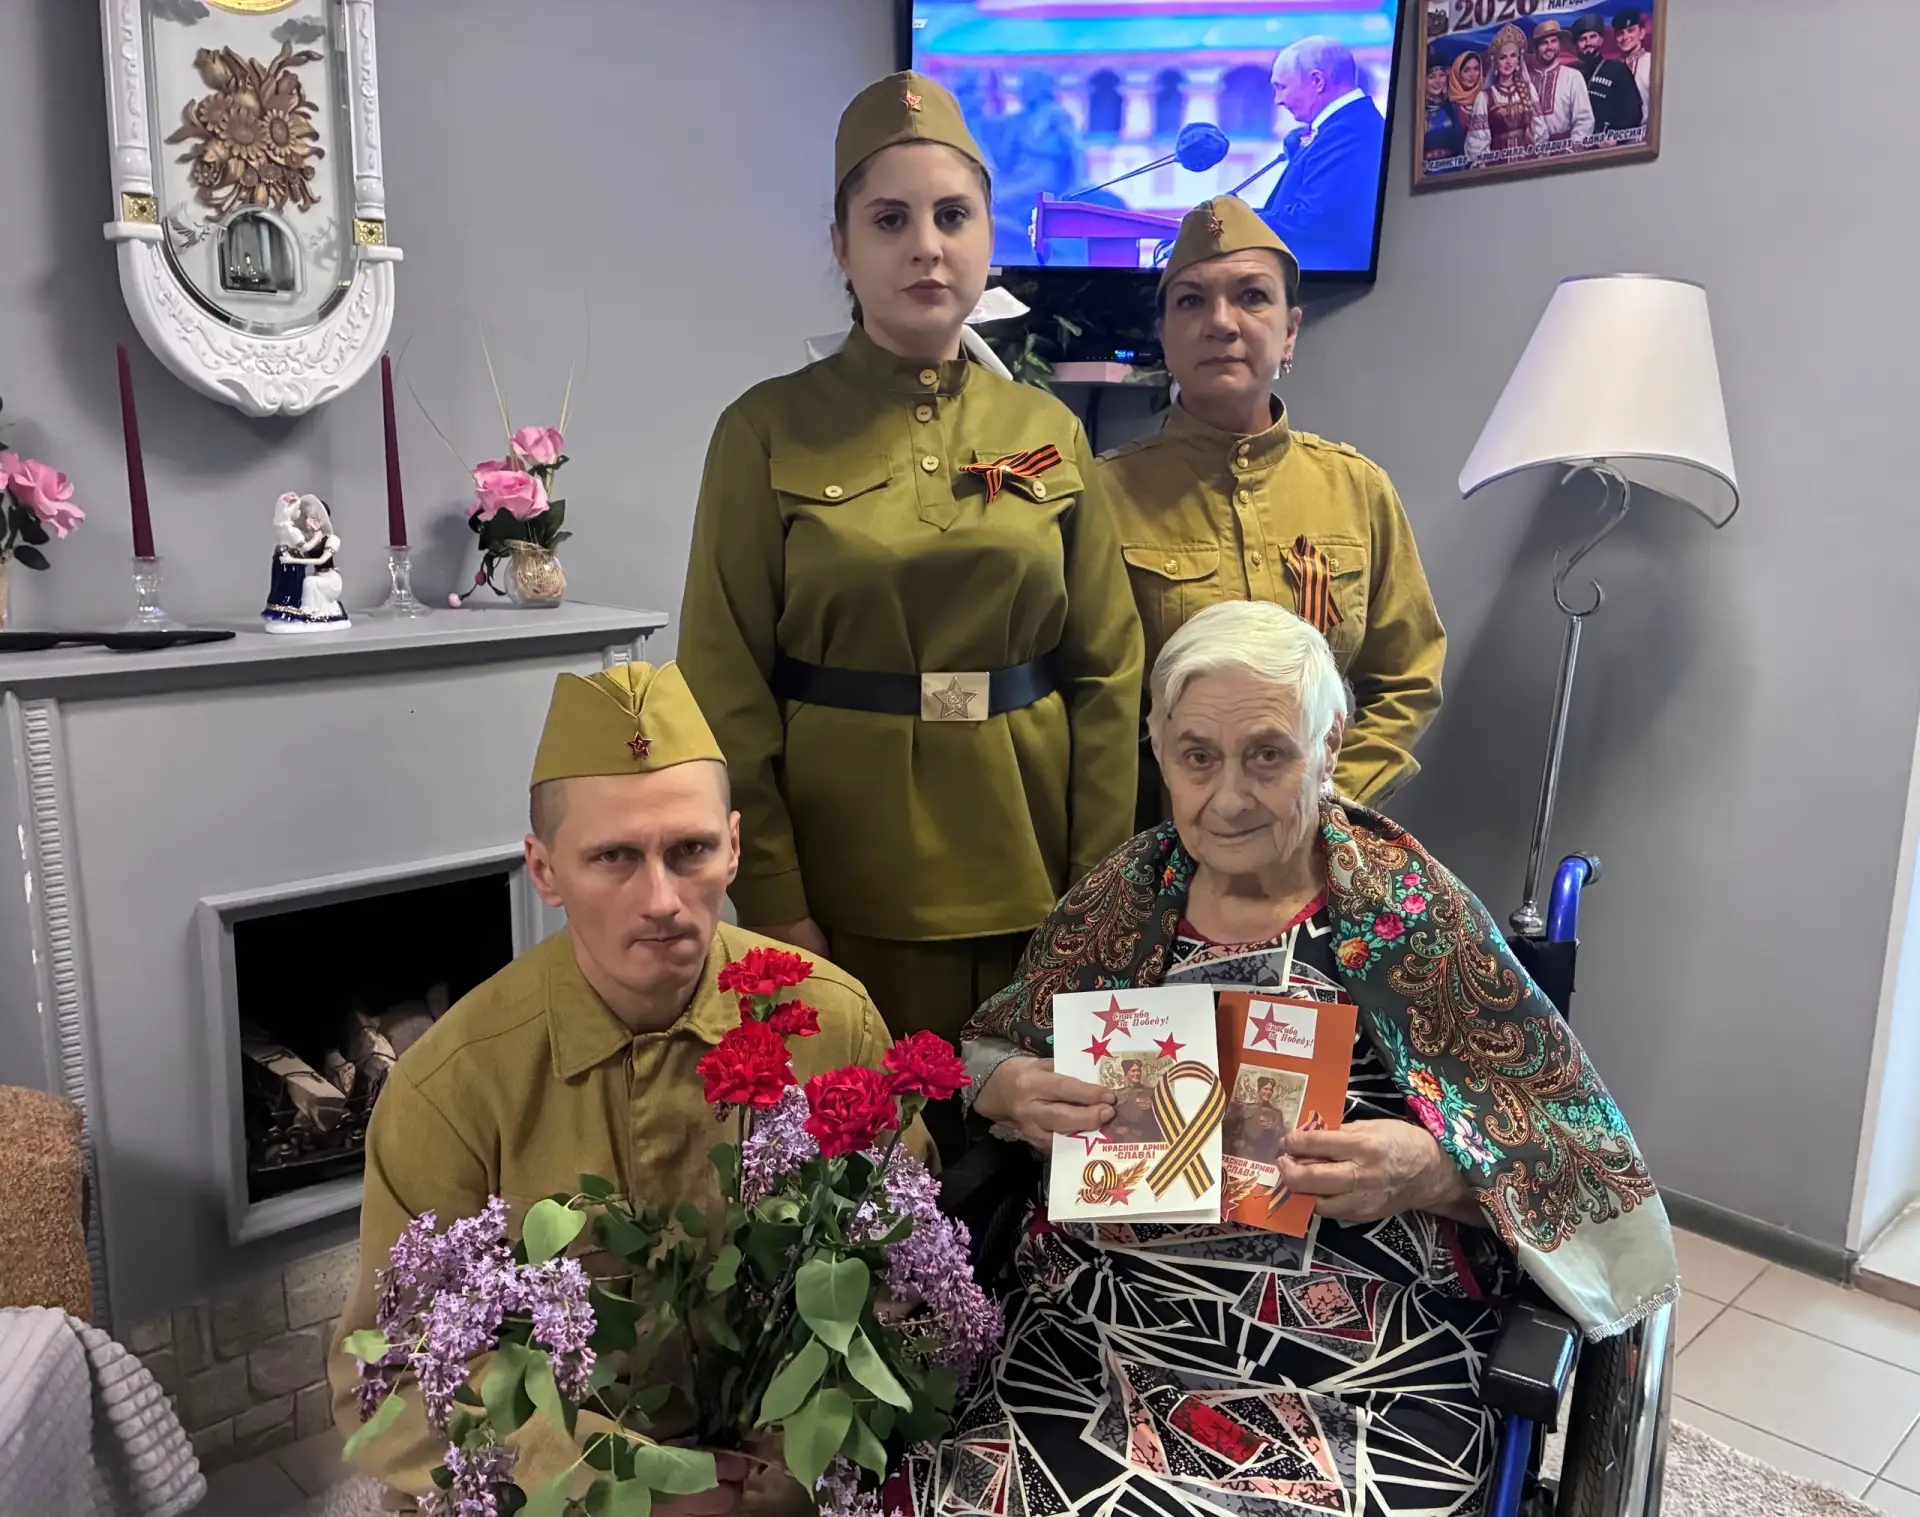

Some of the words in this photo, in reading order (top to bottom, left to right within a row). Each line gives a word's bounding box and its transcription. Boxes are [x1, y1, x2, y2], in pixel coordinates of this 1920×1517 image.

[1453, 0, 1538, 32] 2020
[1112, 1009, 1150, 1021] Спасибо
[1132, 1016, 1169, 1027] Победу!
[1265, 1022, 1298, 1036] Спасибо
[1280, 1034, 1314, 1048] Победу!
[1102, 1144, 1140, 1153] КРАСНОЙ
[1222, 1155, 1249, 1168] АСНОЙ
[1250, 1162, 1276, 1174] АРМИИ
